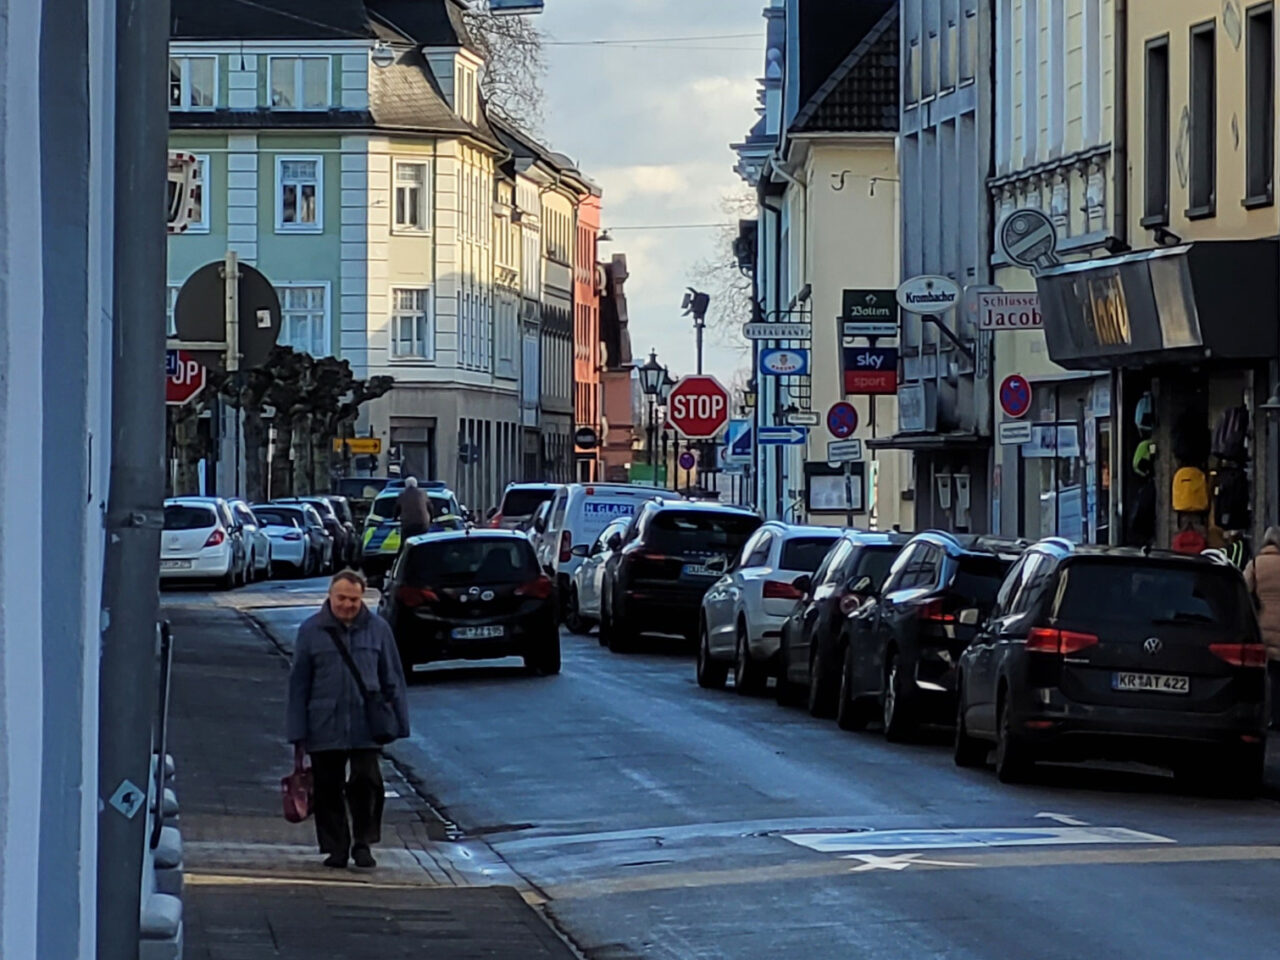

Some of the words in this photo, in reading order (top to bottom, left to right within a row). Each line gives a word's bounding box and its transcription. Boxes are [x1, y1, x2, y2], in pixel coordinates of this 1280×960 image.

[905, 291, 956, 304] Krombacher
[856, 352, 884, 369] sky
[854, 377, 886, 387] sport
[674, 395, 724, 419] STOP
[1120, 674, 1136, 687] KR
[1145, 676, 1160, 688] AT
[1163, 678, 1187, 690] 422
